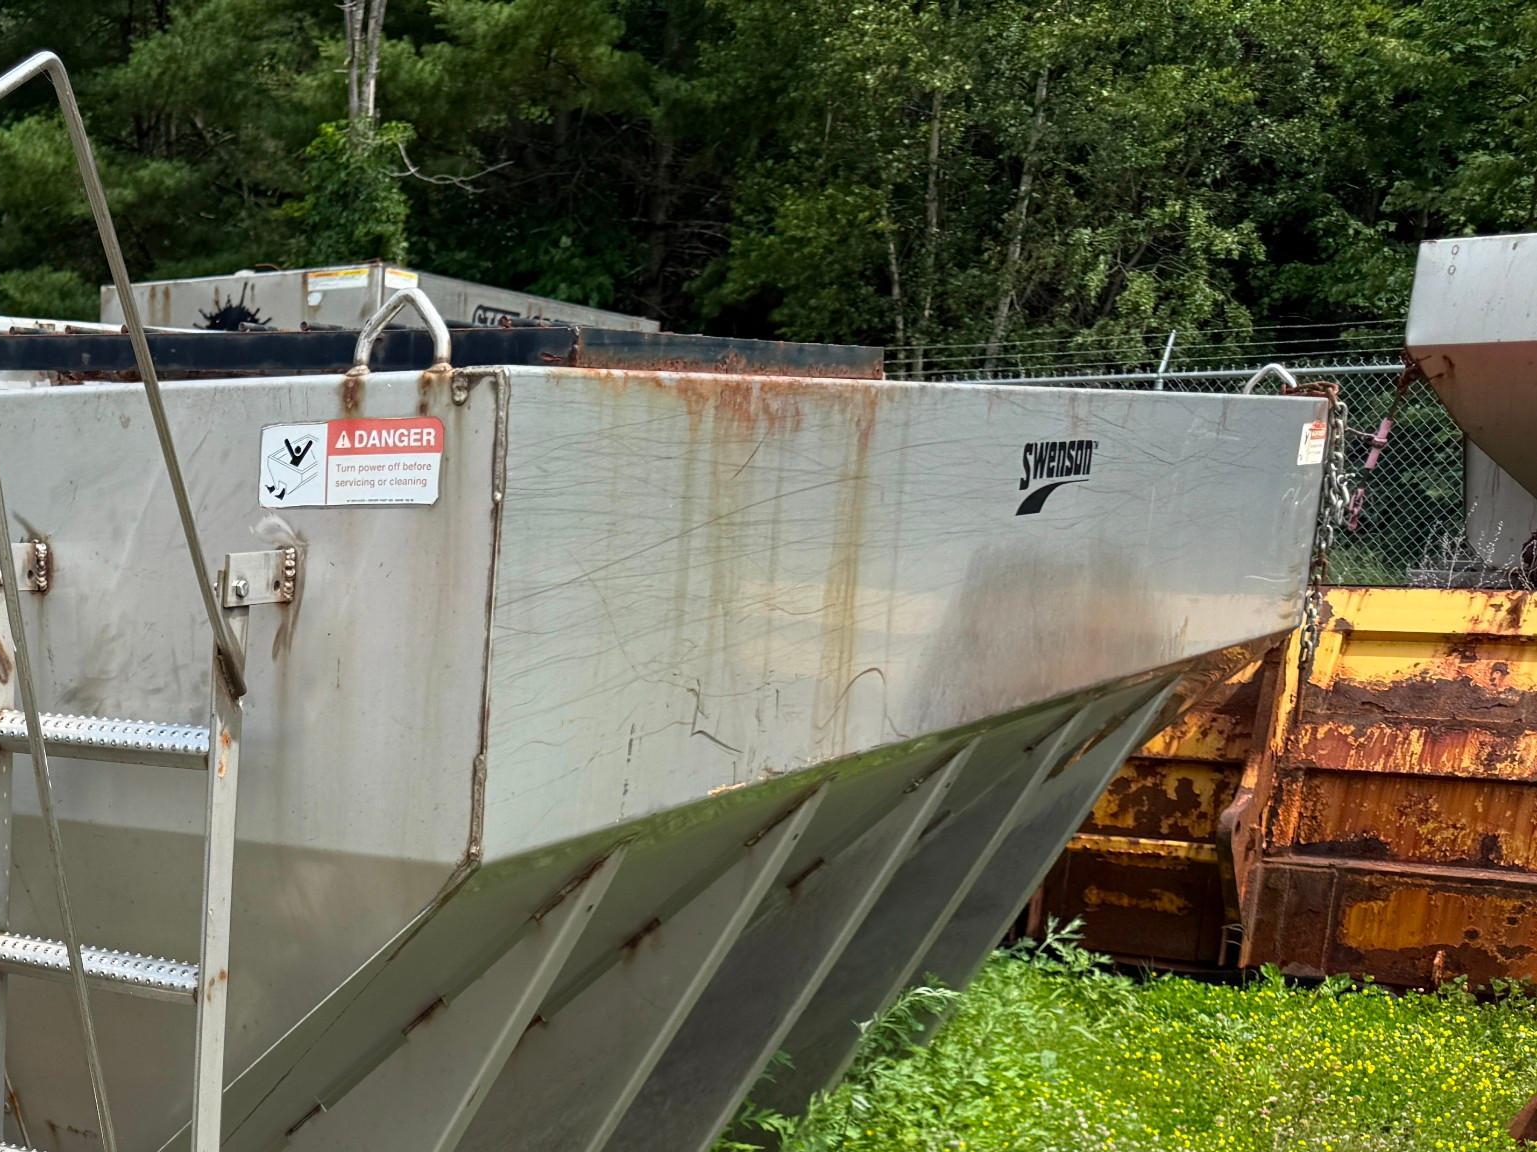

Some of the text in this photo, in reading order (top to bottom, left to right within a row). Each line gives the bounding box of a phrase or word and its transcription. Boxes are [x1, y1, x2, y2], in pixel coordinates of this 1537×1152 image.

[354, 428, 436, 448] DANGER
[336, 461, 432, 474] Turn power off before
[335, 479, 375, 488] servicing
[389, 477, 428, 488] cleaning
